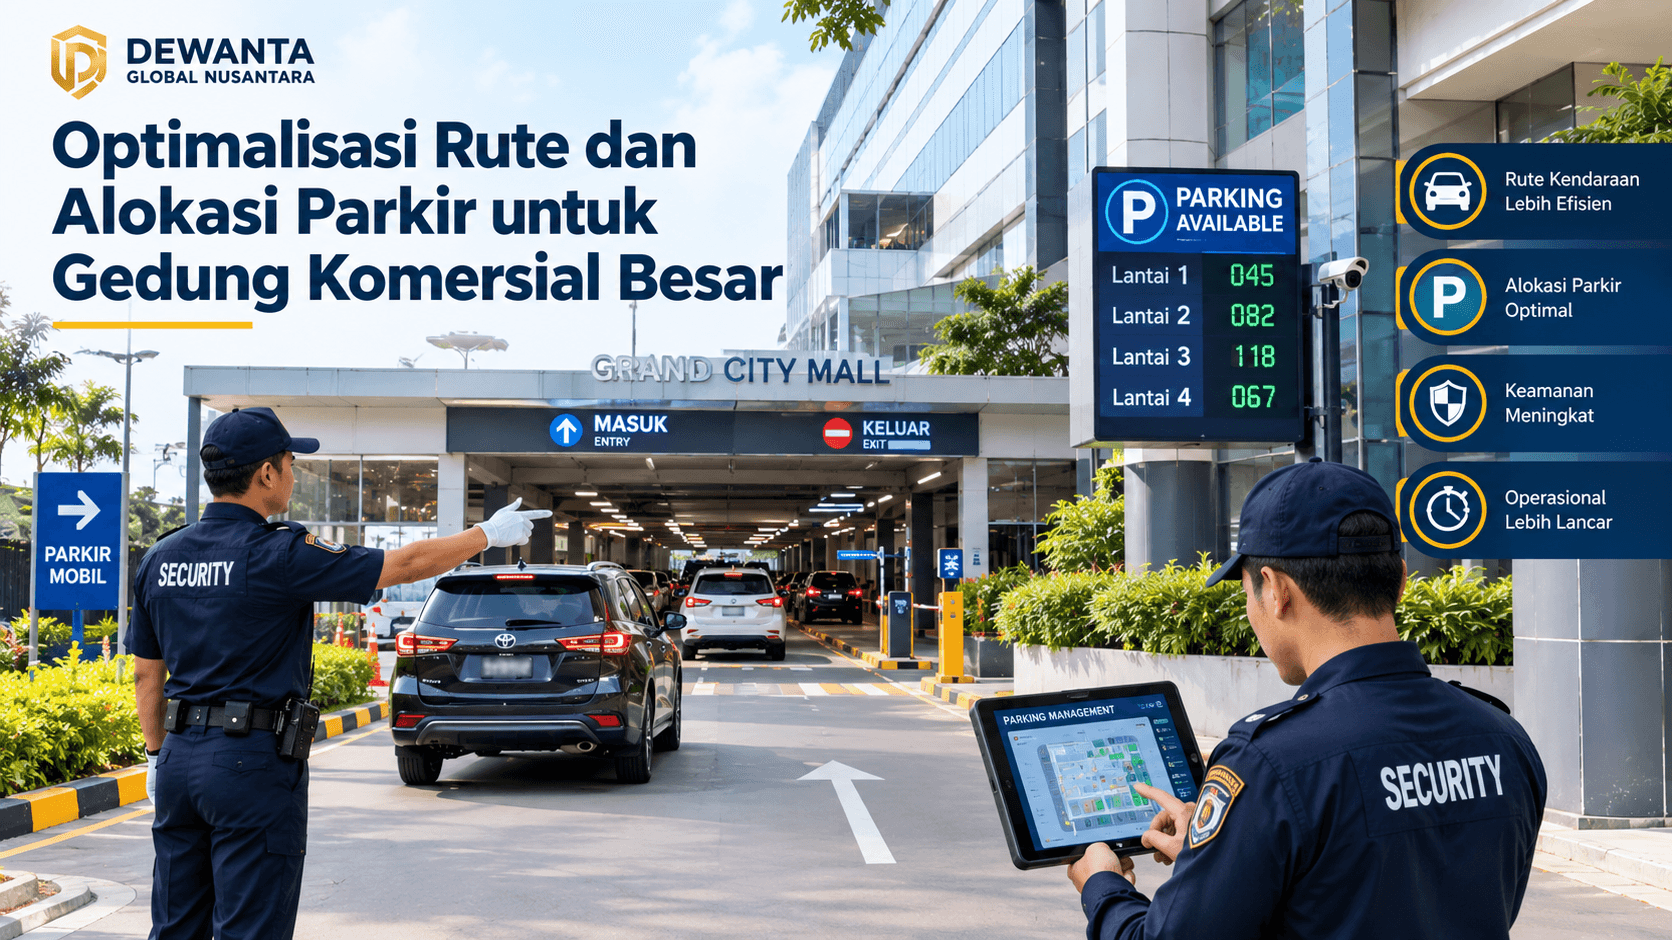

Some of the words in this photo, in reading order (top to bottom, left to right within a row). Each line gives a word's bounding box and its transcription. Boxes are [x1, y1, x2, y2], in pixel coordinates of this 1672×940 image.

[1176, 187, 1283, 209] PARKING
[1122, 190, 1156, 234] P
[1176, 214, 1284, 232] AVAILABLE
[1112, 265, 1169, 284] Lantai
[1178, 265, 1187, 285] 1
[1230, 263, 1274, 287] 045
[1112, 306, 1169, 325] Lantai
[1177, 305, 1191, 325] 2
[1231, 303, 1275, 327] 082
[1112, 347, 1169, 366] Lantai
[1177, 346, 1191, 366] 3
[1235, 344, 1275, 368] 118
[590, 354, 713, 384] GRAND
[724, 356, 797, 384] CITY
[808, 358, 891, 385] MALL
[1113, 388, 1170, 406] Lantai
[1177, 387, 1192, 407] 4
[1231, 384, 1276, 408] 067
[594, 414, 668, 433] MASUK
[863, 420, 930, 437] KELUAR
[594, 437, 631, 447] ENTRY
[863, 439, 887, 450] EXIT
[44, 546, 112, 563] PARKIR
[50, 567, 107, 585] MOBIL
[158, 560, 235, 587] SECURITY
[1003, 712, 1047, 726] PARKING
[1048, 704, 1116, 721] MANAGEMENT
[1380, 754, 1504, 811] SECURITY
